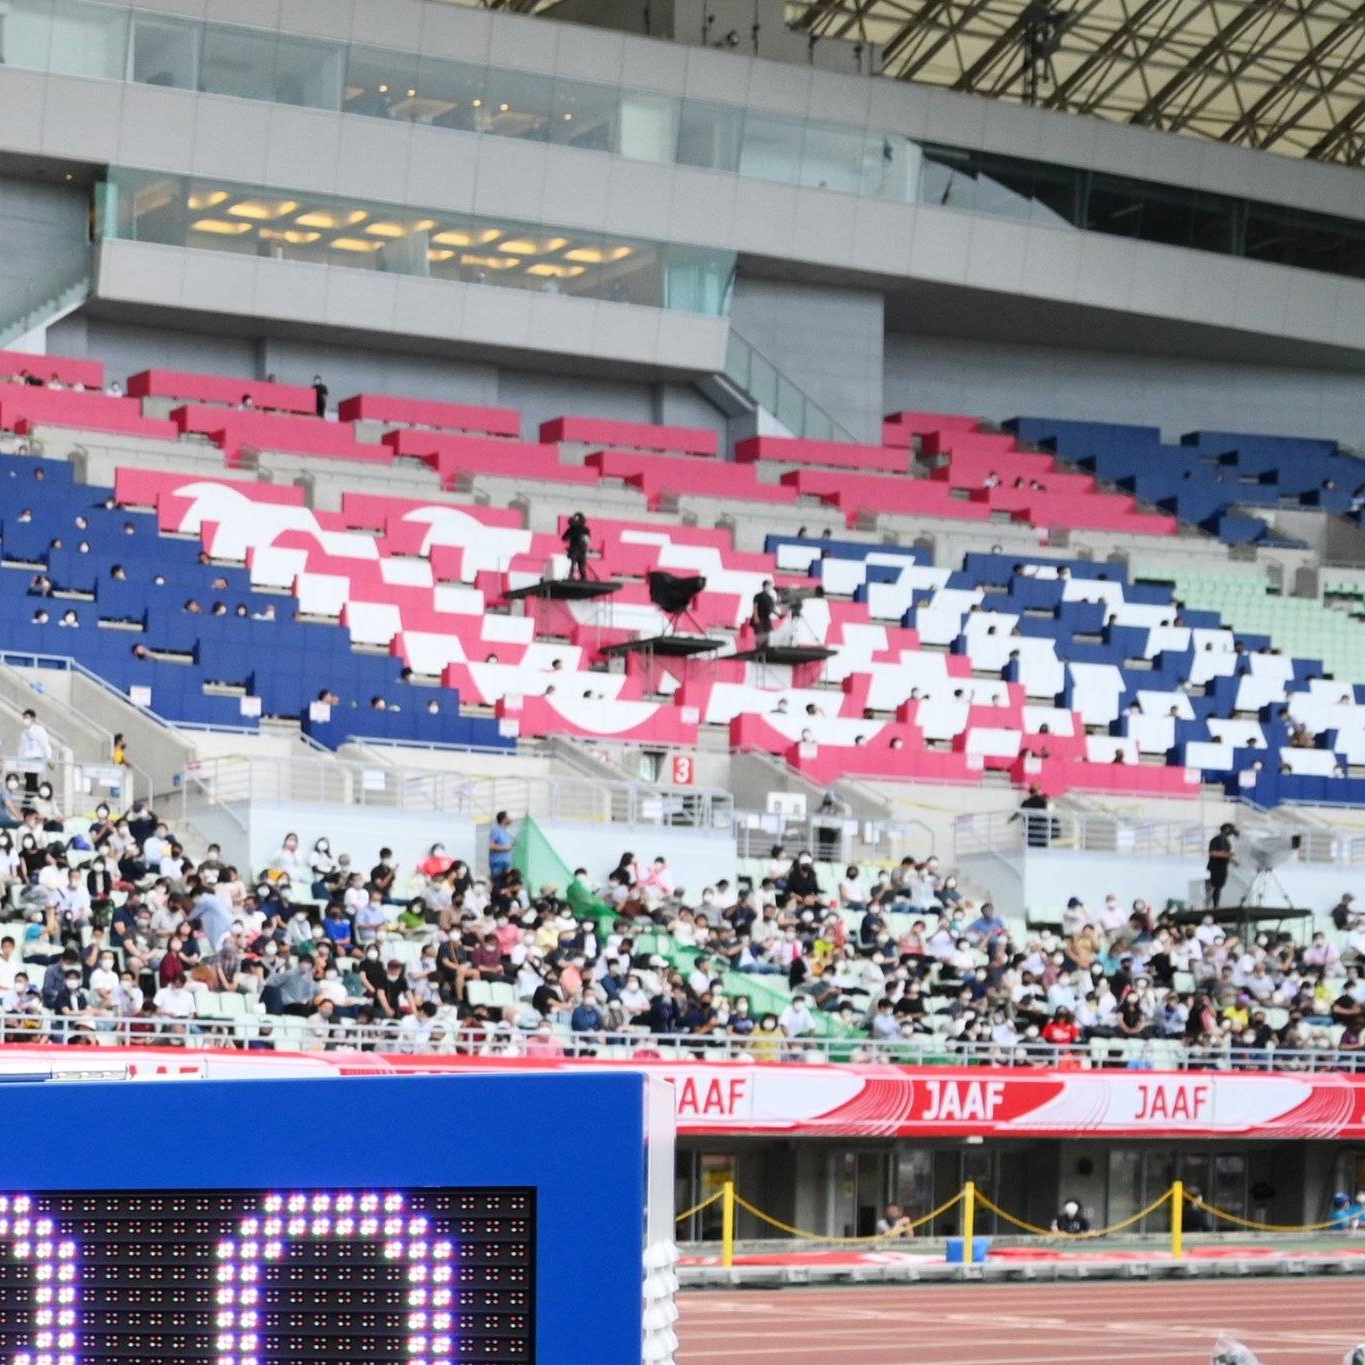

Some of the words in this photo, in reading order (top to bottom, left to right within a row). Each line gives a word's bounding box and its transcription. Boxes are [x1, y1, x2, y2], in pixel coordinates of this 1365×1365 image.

[674, 756, 690, 784] 3
[922, 1080, 1006, 1122] JAAF
[1135, 1085, 1209, 1120] JAAF
